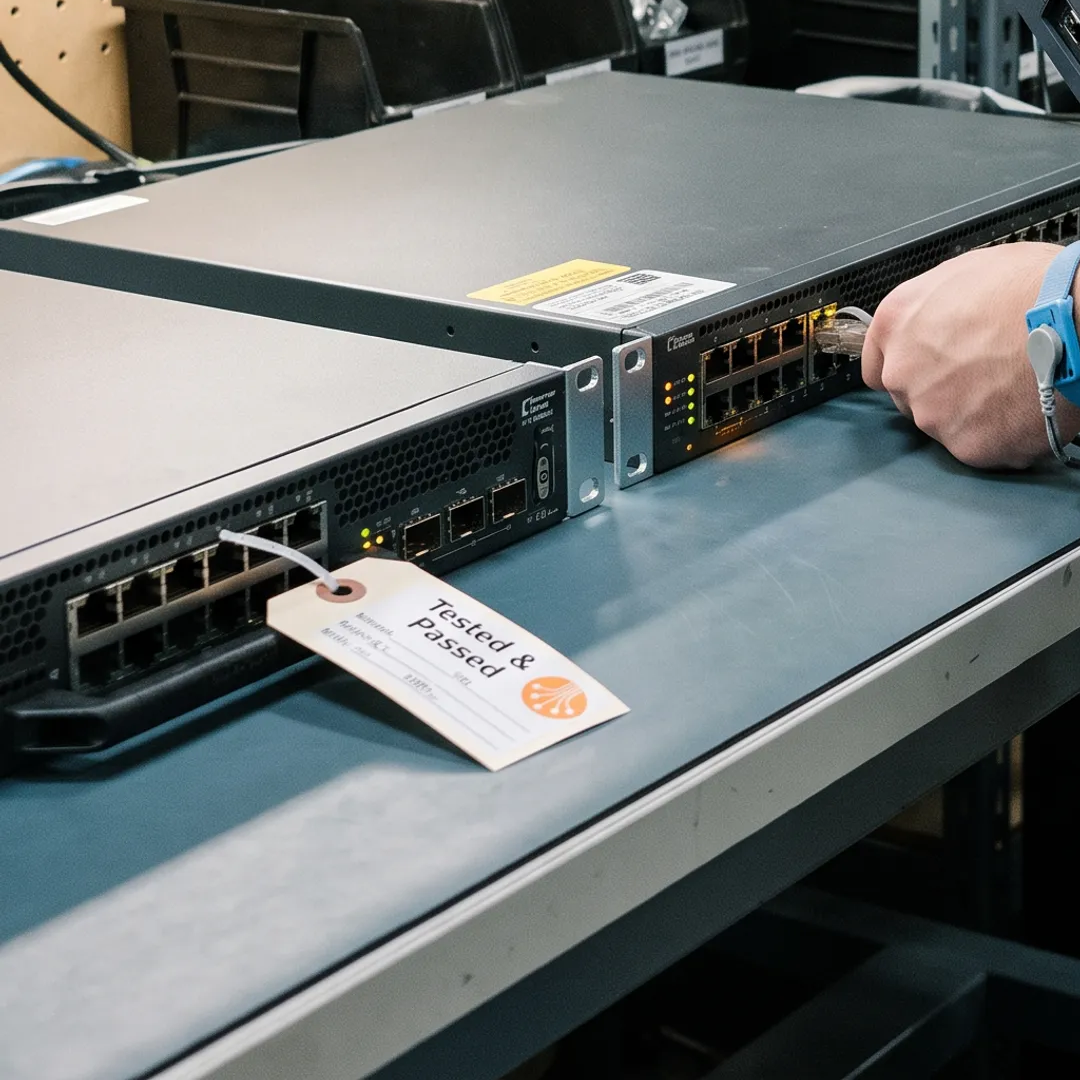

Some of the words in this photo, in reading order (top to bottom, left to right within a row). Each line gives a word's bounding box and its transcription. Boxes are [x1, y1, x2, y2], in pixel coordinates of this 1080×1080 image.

[407, 617, 506, 678] Passed
[429, 598, 515, 652] Tested
[510, 653, 535, 671] &
